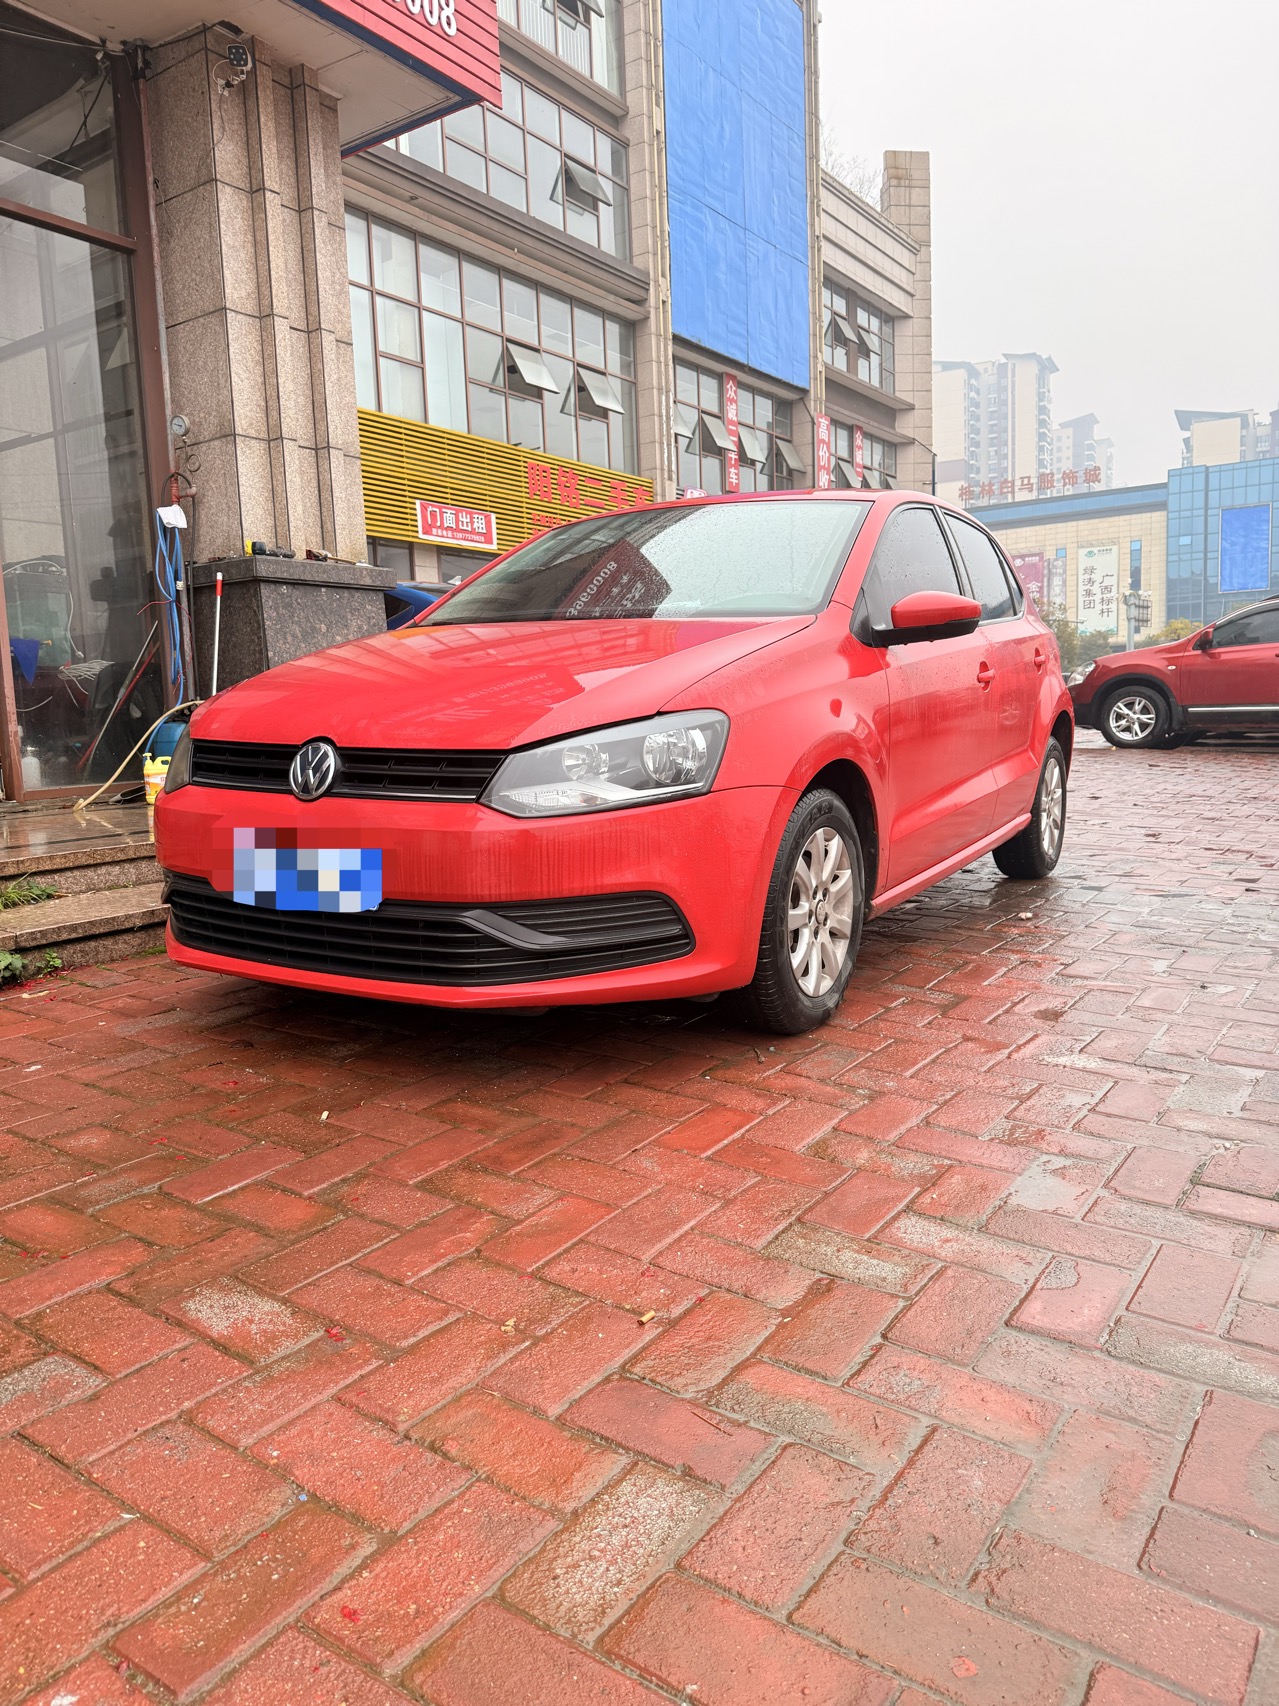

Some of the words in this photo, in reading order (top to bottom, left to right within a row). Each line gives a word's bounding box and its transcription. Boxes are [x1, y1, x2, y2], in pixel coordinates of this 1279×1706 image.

[726, 380, 739, 487] 众诚二手车
[958, 465, 1102, 502] 桂林白马服饰城
[427, 505, 487, 534] 门面出租
[1082, 565, 1098, 610] 绿涛集团
[1098, 573, 1114, 618] 广西标杆
